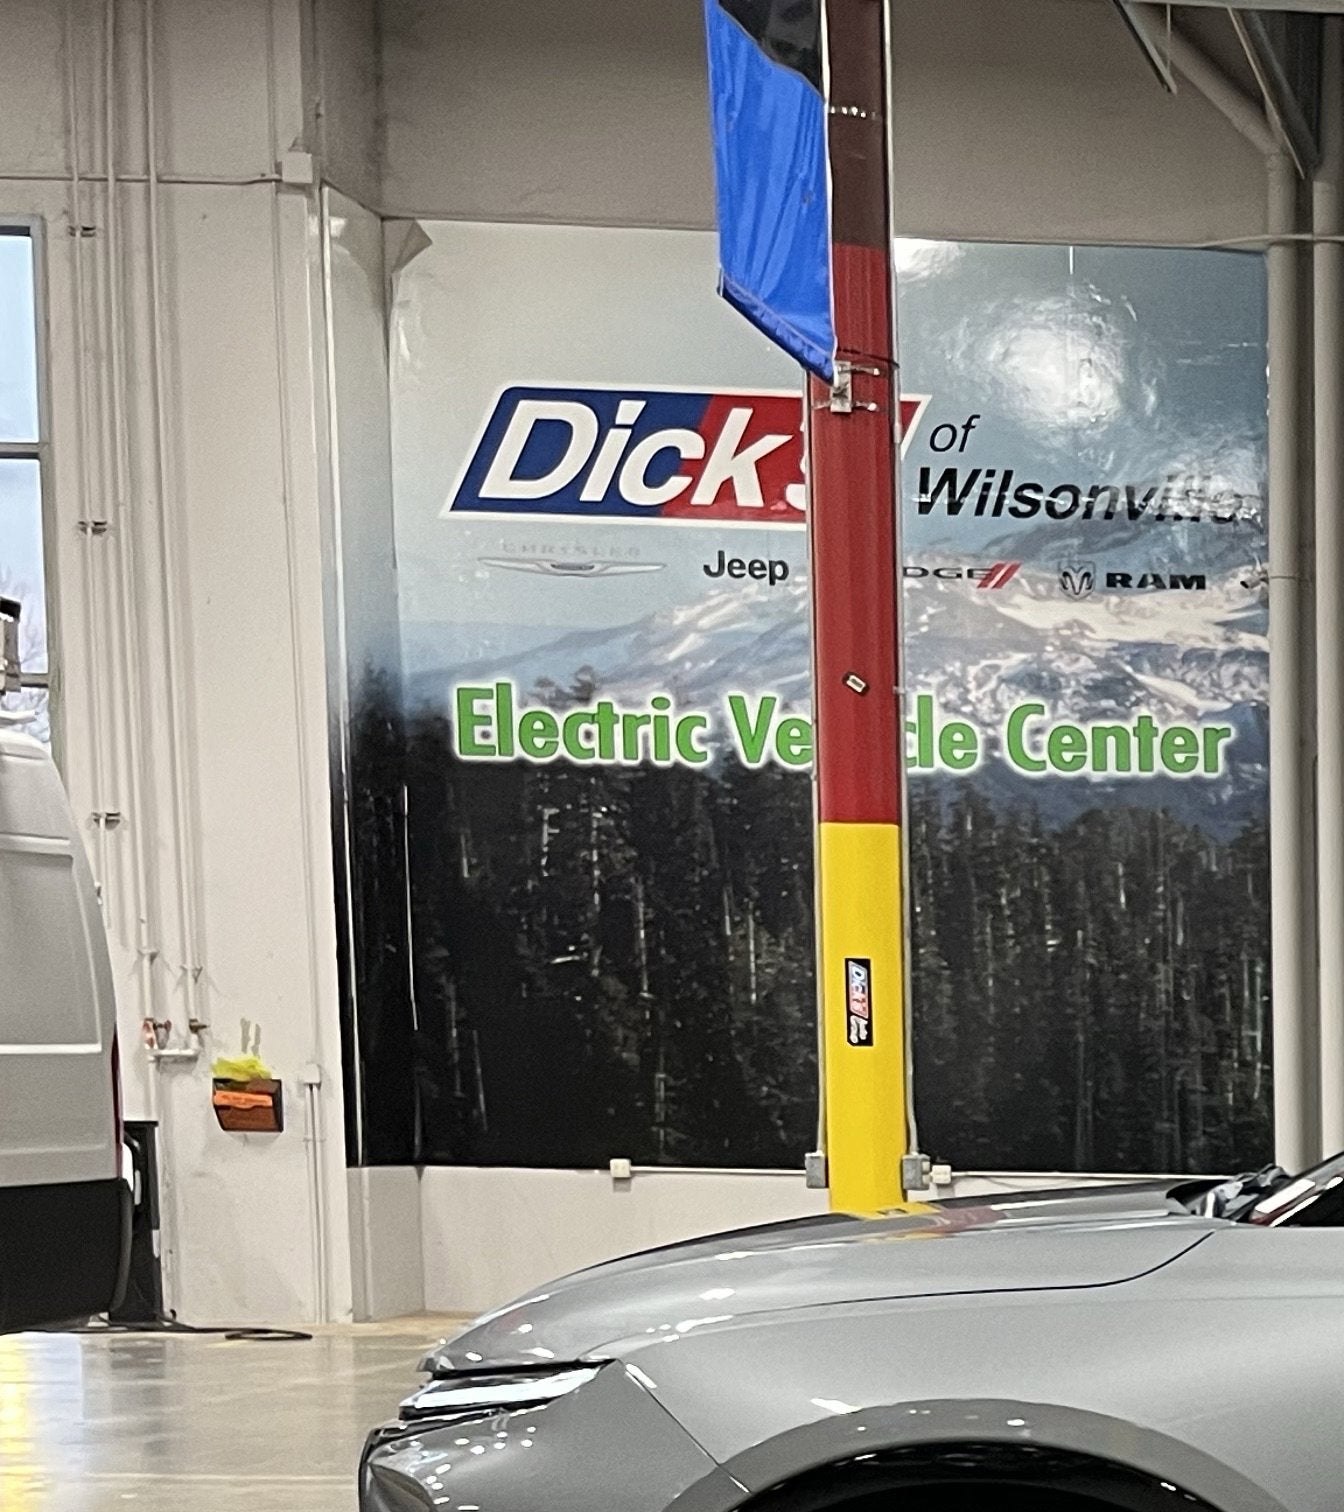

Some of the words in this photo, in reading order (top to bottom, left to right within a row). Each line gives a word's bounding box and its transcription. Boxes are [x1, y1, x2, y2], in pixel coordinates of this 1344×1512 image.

[478, 399, 807, 512] Dick
[929, 414, 981, 453] of
[703, 550, 789, 586] Jeep
[1106, 573, 1206, 590] RAM
[457, 682, 709, 763] Electric
[1007, 704, 1232, 773] Center
